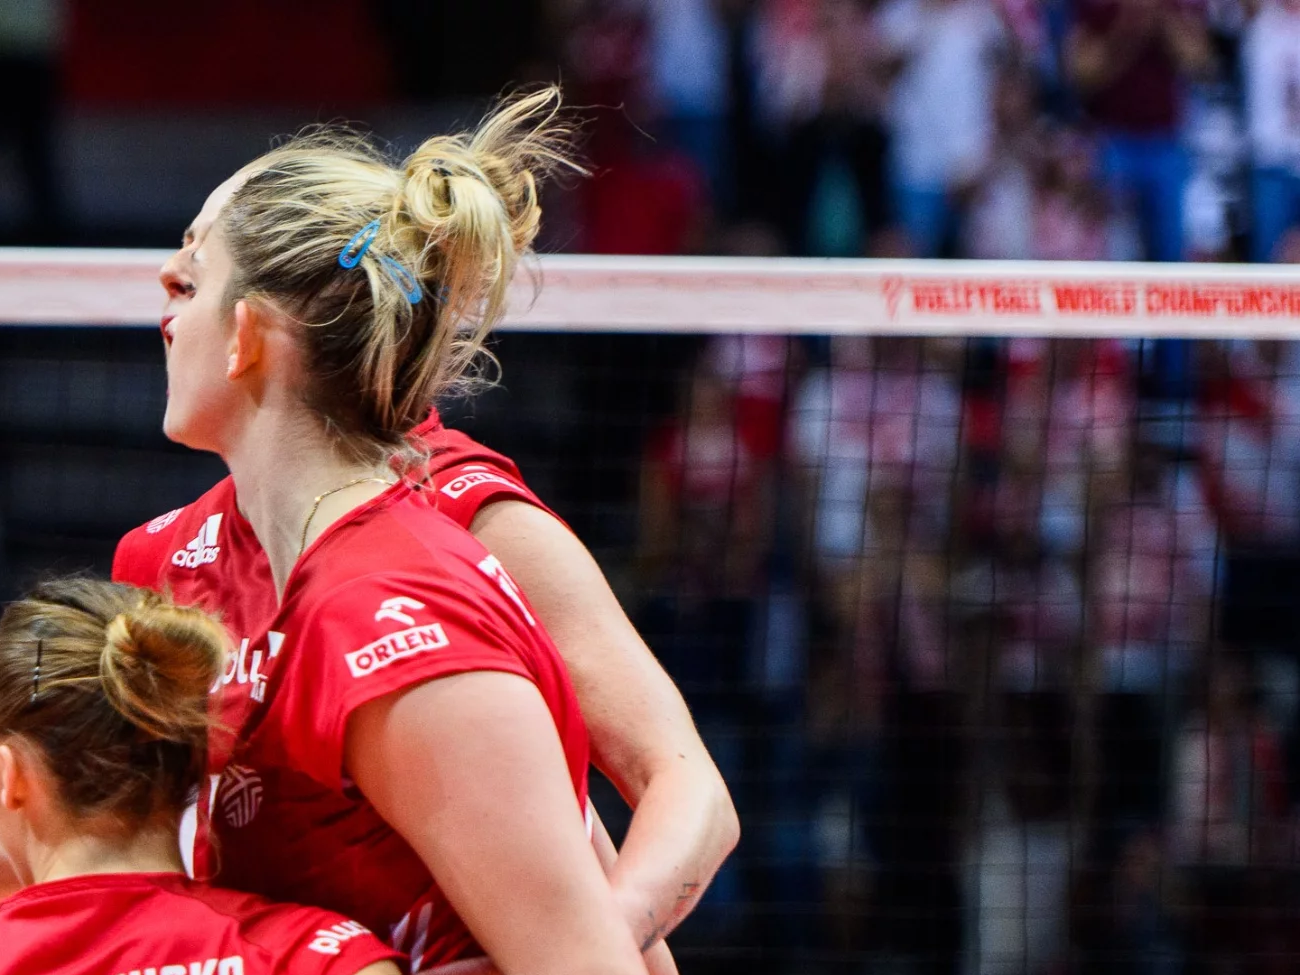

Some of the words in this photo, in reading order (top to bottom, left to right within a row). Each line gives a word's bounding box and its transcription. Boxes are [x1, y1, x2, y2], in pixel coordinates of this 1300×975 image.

[911, 280, 1042, 314] VOLLEYBALL
[1052, 281, 1138, 316] WORLD
[356, 629, 440, 670] ORLEN
